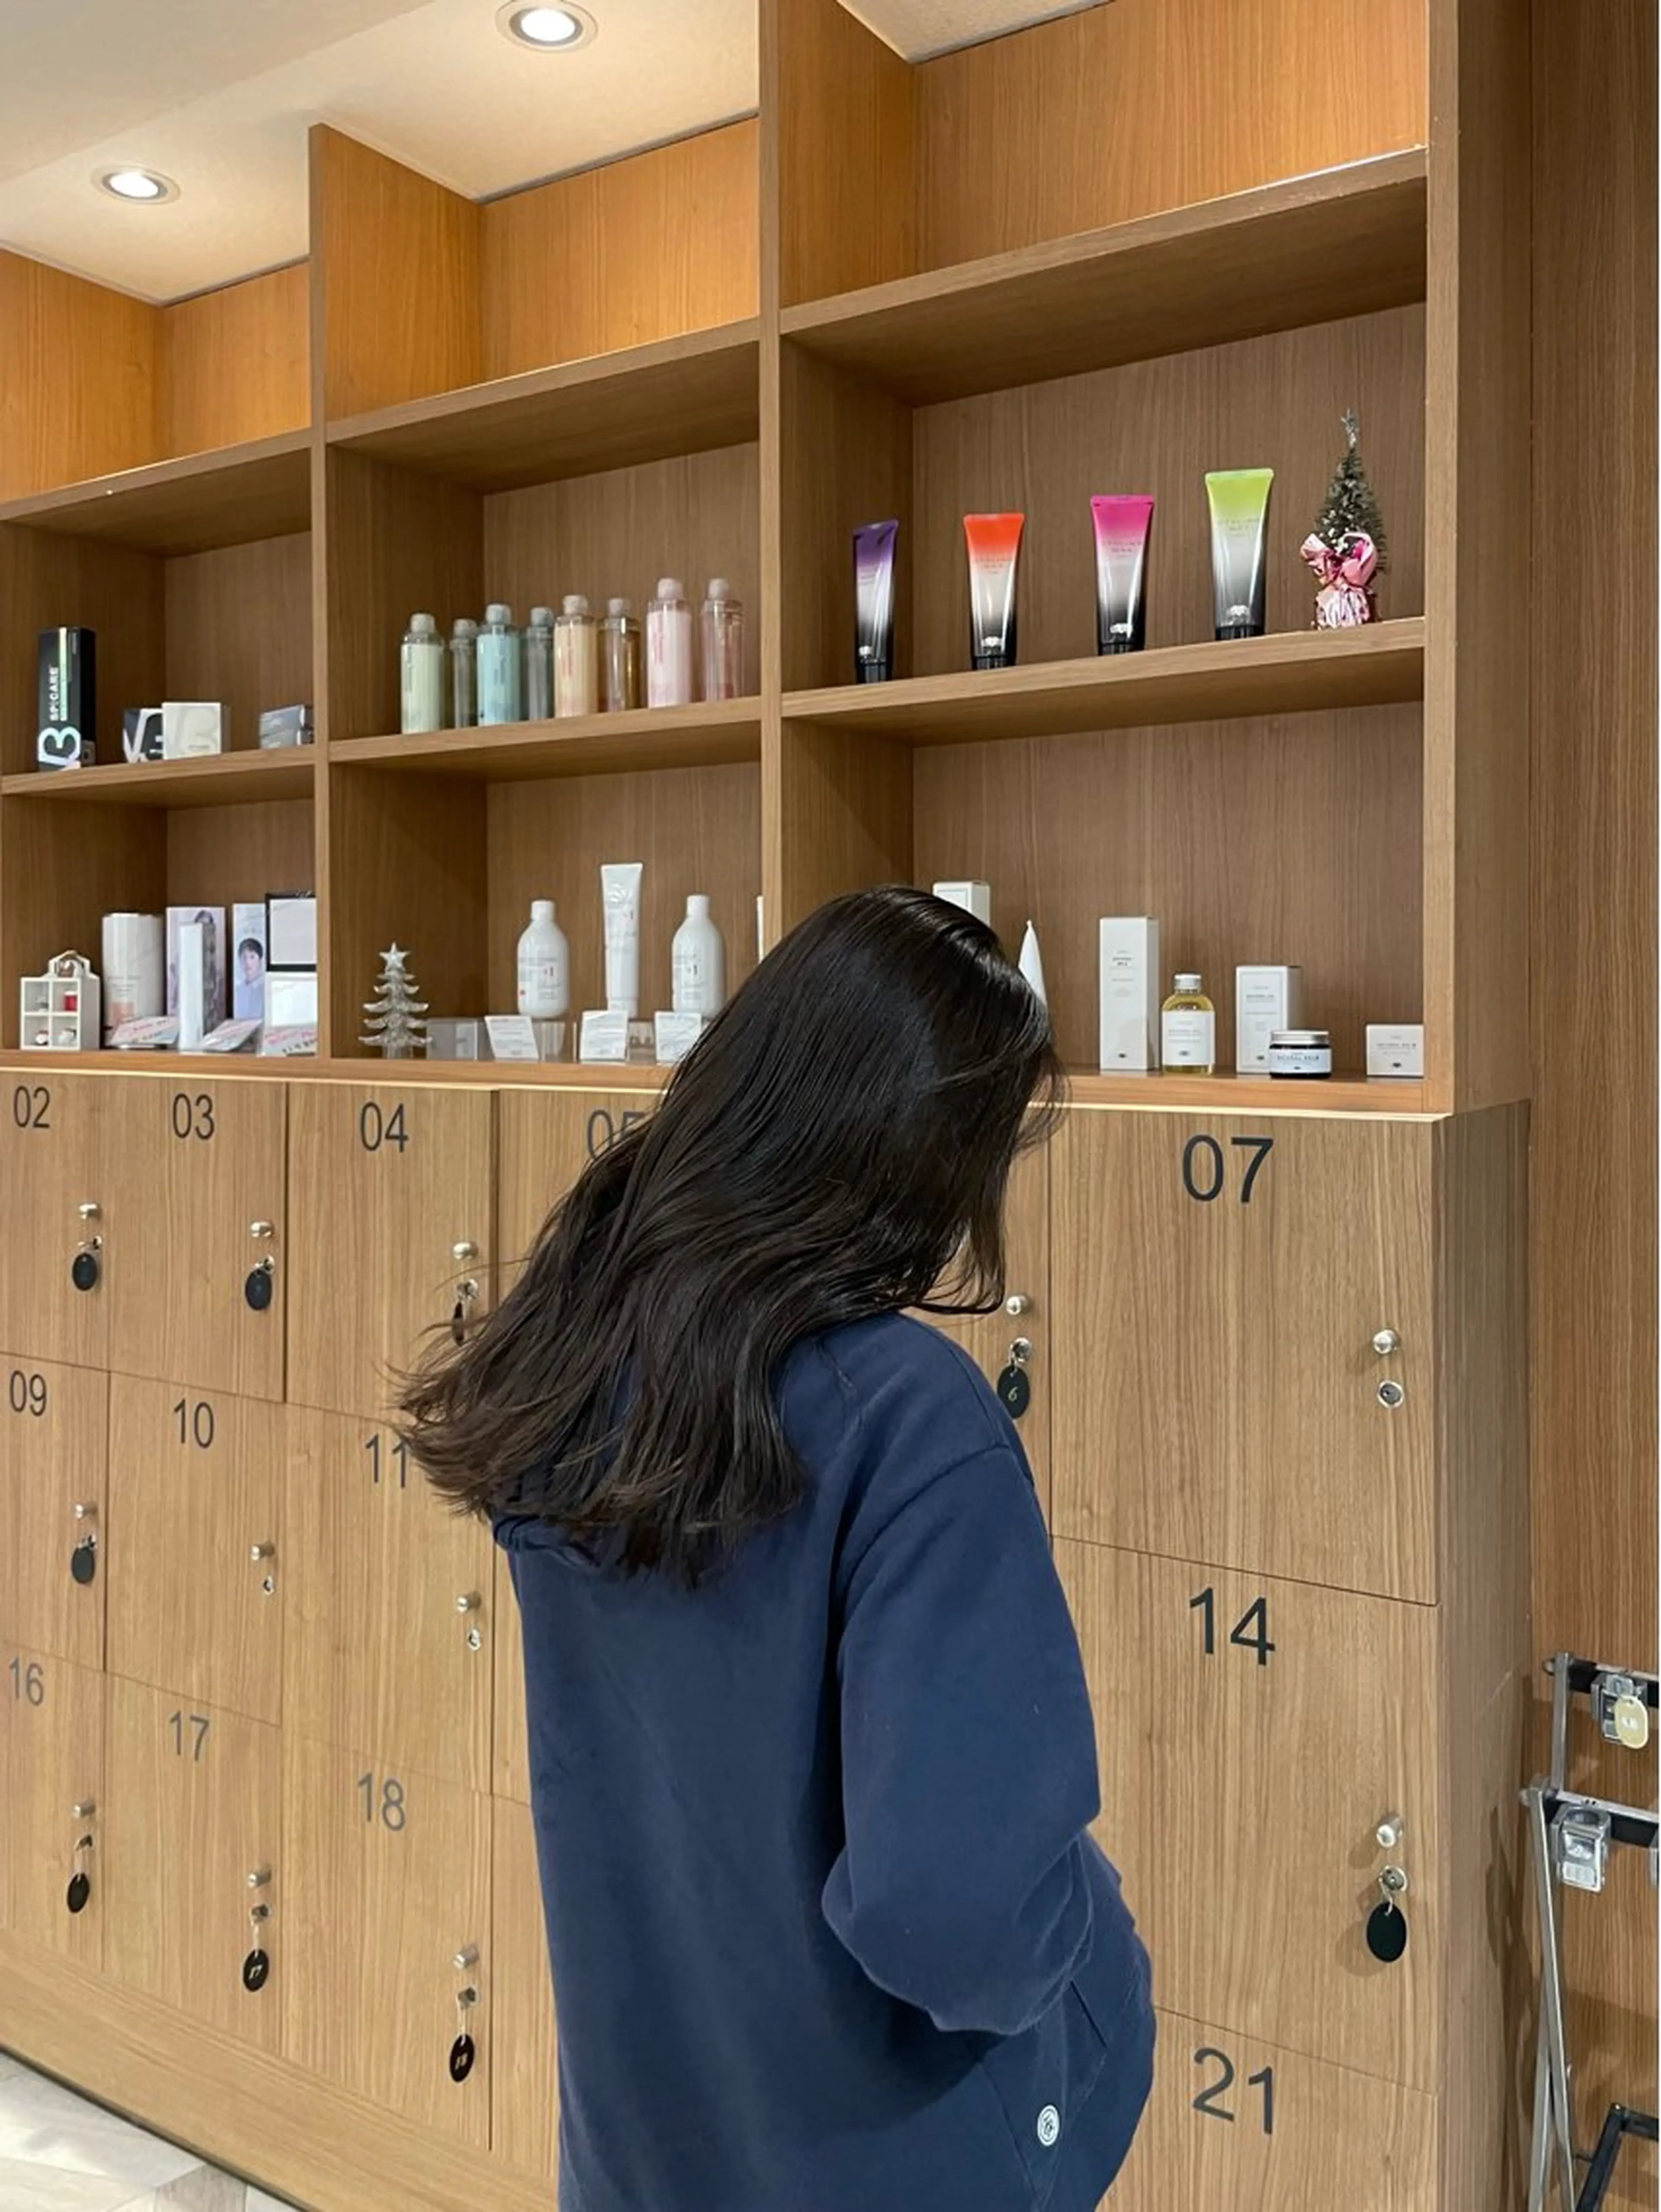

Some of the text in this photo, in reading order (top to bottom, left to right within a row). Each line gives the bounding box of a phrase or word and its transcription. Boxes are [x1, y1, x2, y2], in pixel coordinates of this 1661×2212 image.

[13, 1086, 50, 1129] 02
[173, 1093, 215, 1140] 03
[361, 1102, 409, 1153] 04
[1183, 1135, 1273, 1203] 07
[10, 1370, 47, 1417] 09
[1008, 1386, 1019, 1402] 6
[174, 1398, 214, 1448] 10
[366, 1433, 406, 1488] 11
[1190, 1587, 1276, 1666] 14
[9, 1657, 44, 1706] 16
[170, 1710, 209, 1761] 17
[358, 1772, 405, 1831] 18
[1193, 2047, 1273, 2135] 21
